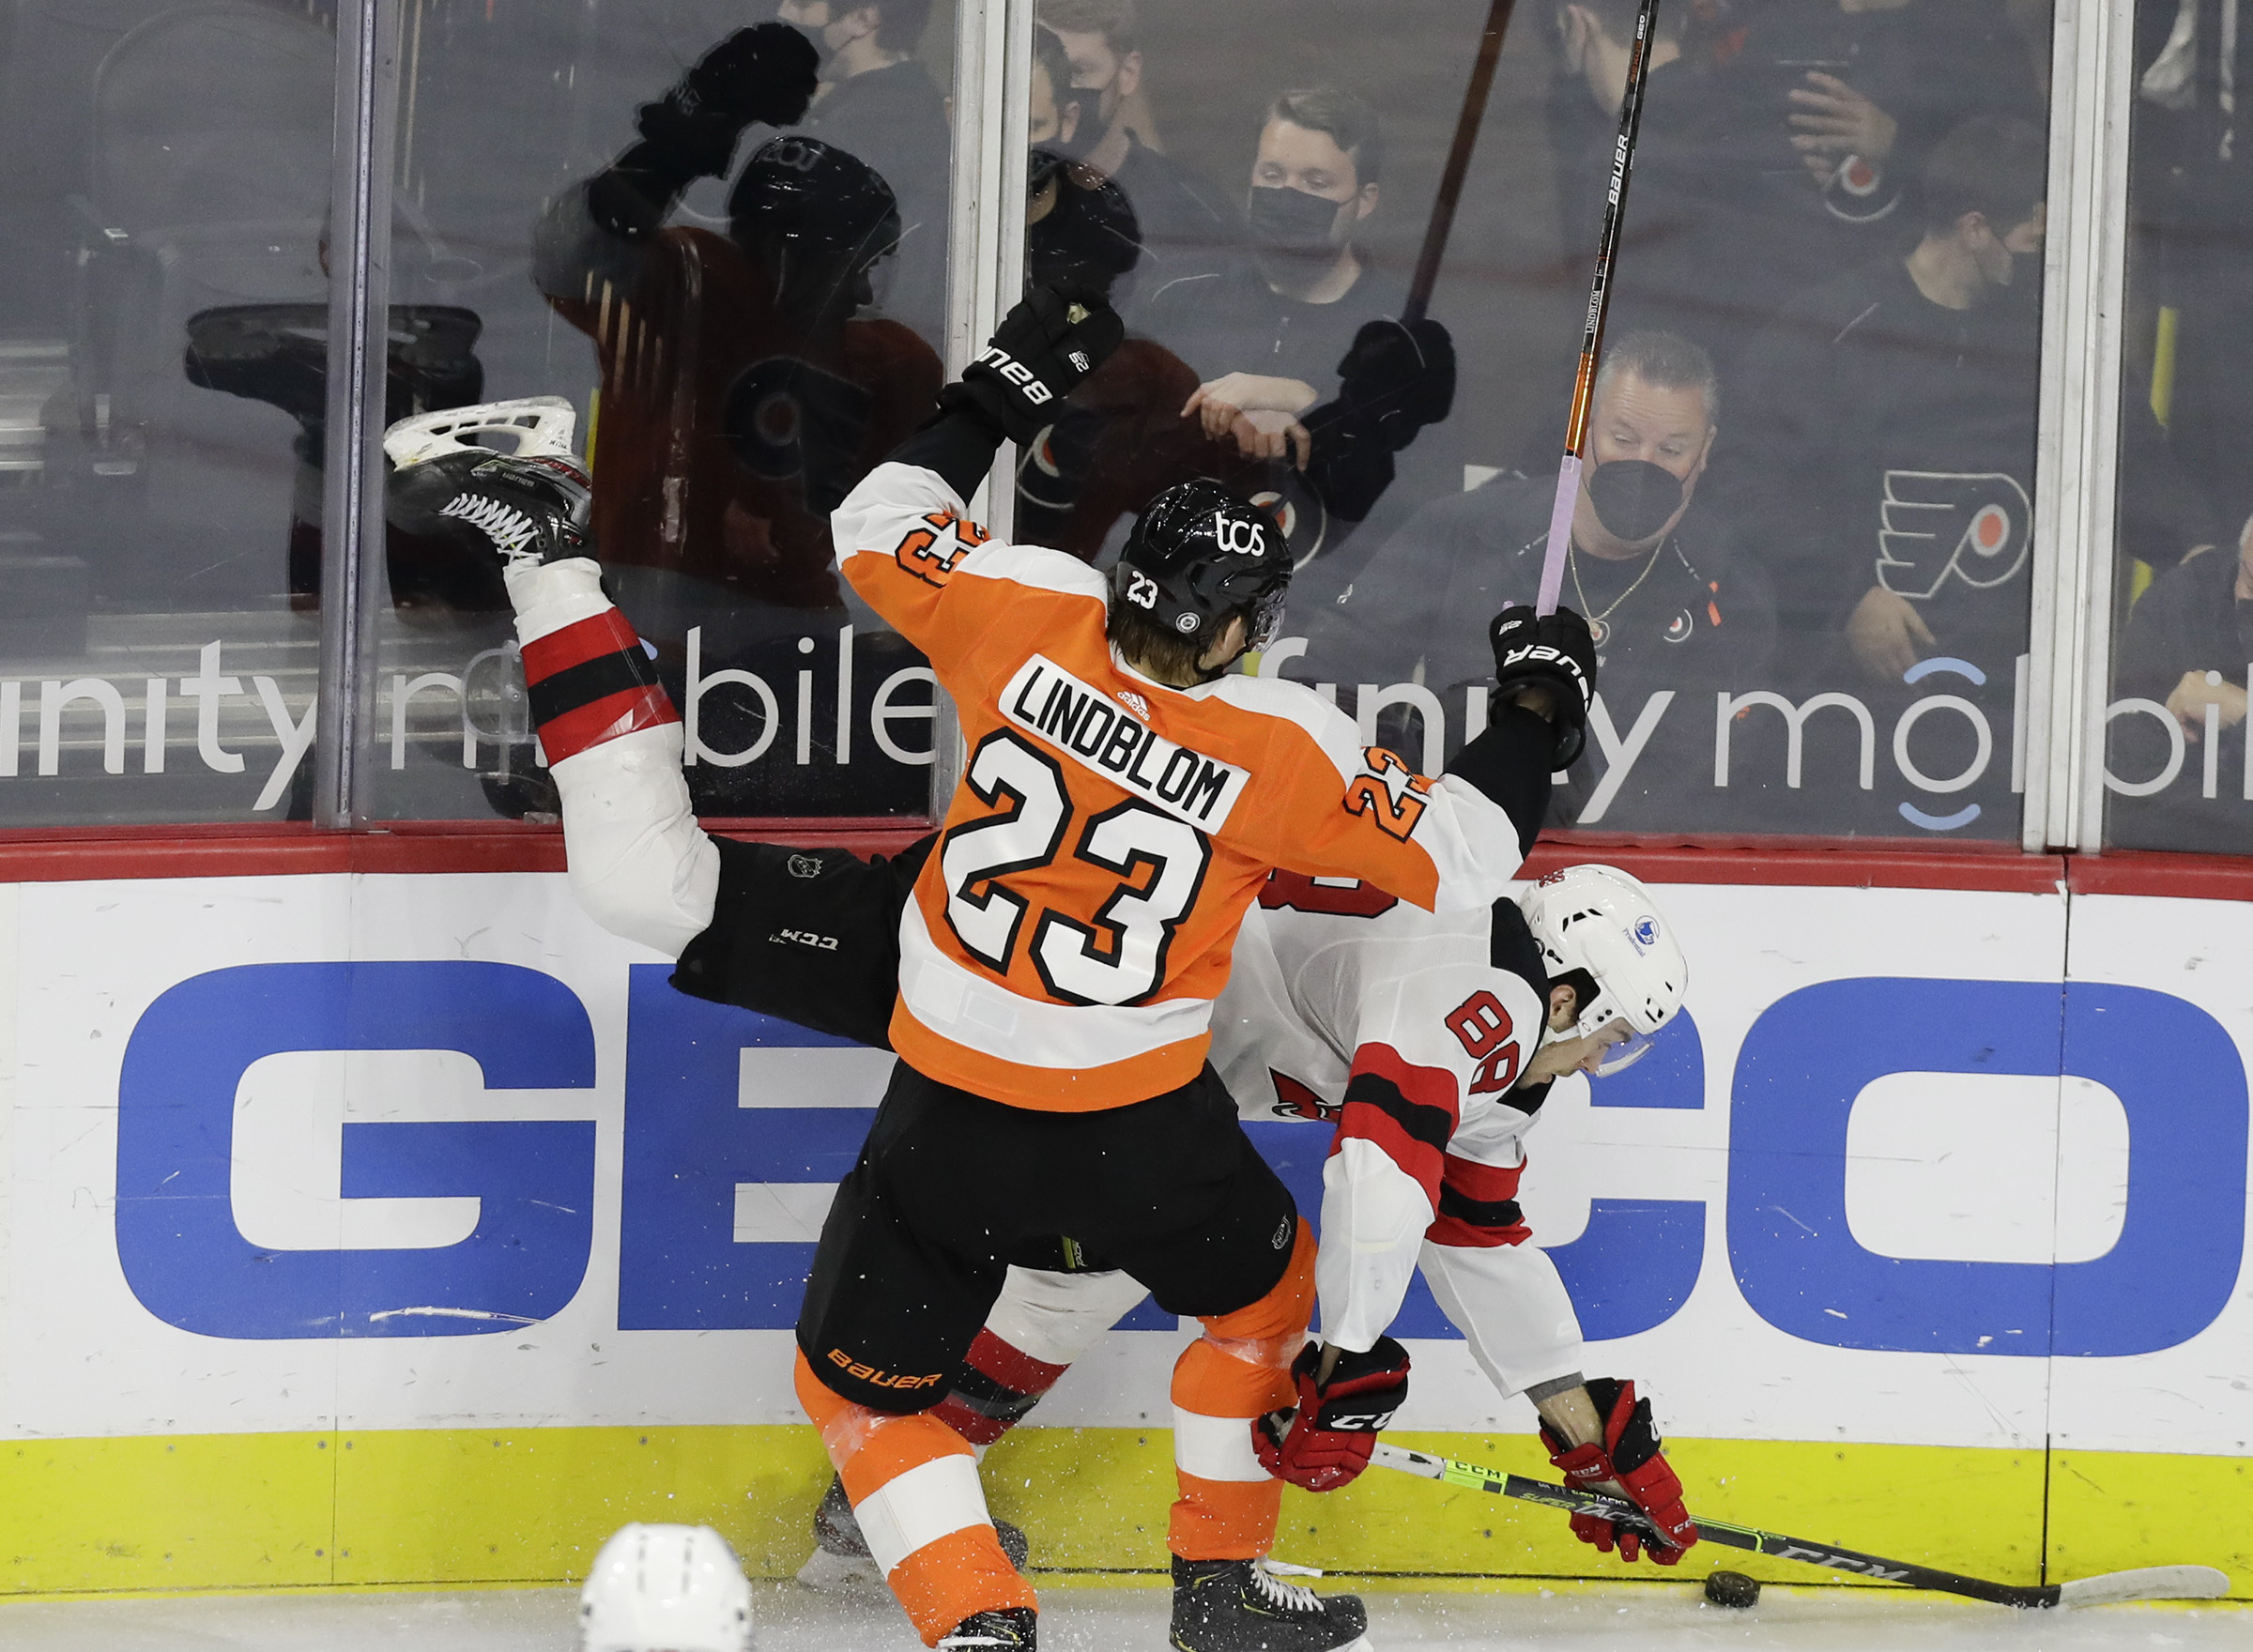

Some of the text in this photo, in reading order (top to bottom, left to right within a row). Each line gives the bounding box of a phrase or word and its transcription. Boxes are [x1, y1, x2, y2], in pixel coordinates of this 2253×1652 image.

[1586, 289, 1601, 334] LINDBLOM
[1215, 511, 1265, 558] tcs
[1126, 570, 1158, 610] 23
[391, 623, 937, 770] mbile
[1116, 691, 1151, 722] adidas
[1013, 665, 1231, 821] LINDBLOM
[941, 726, 1213, 1006] 23
[780, 928, 839, 951] CCM
[1622, 927, 1646, 958] Prudential
[826, 1348, 943, 1389] BAUER
[1454, 1461, 1501, 1479] CCM
[1571, 1462, 1601, 1476] CCM
[1519, 1491, 1577, 1509] SUPER
[1774, 1544, 1910, 1582] CCM
